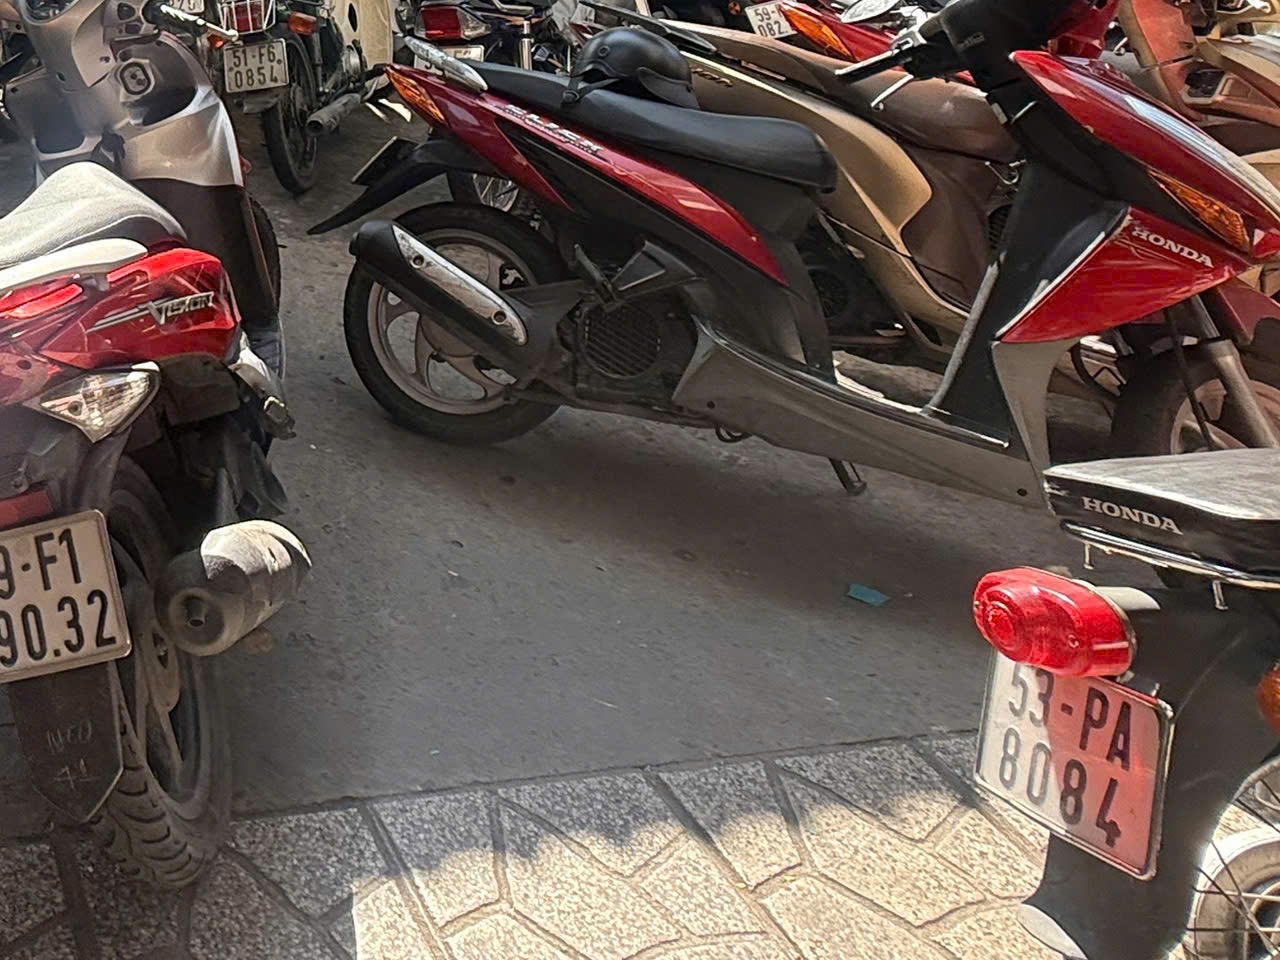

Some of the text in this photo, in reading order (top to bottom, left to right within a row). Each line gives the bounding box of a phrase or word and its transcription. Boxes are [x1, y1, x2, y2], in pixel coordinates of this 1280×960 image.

[232, 44, 276, 68] 51-F6
[234, 65, 278, 89] 0854
[1132, 226, 1214, 269] HONDA
[1082, 496, 1183, 536] HONDA
[1008, 665, 1132, 772] 53-PA
[999, 727, 1122, 848] 8084
